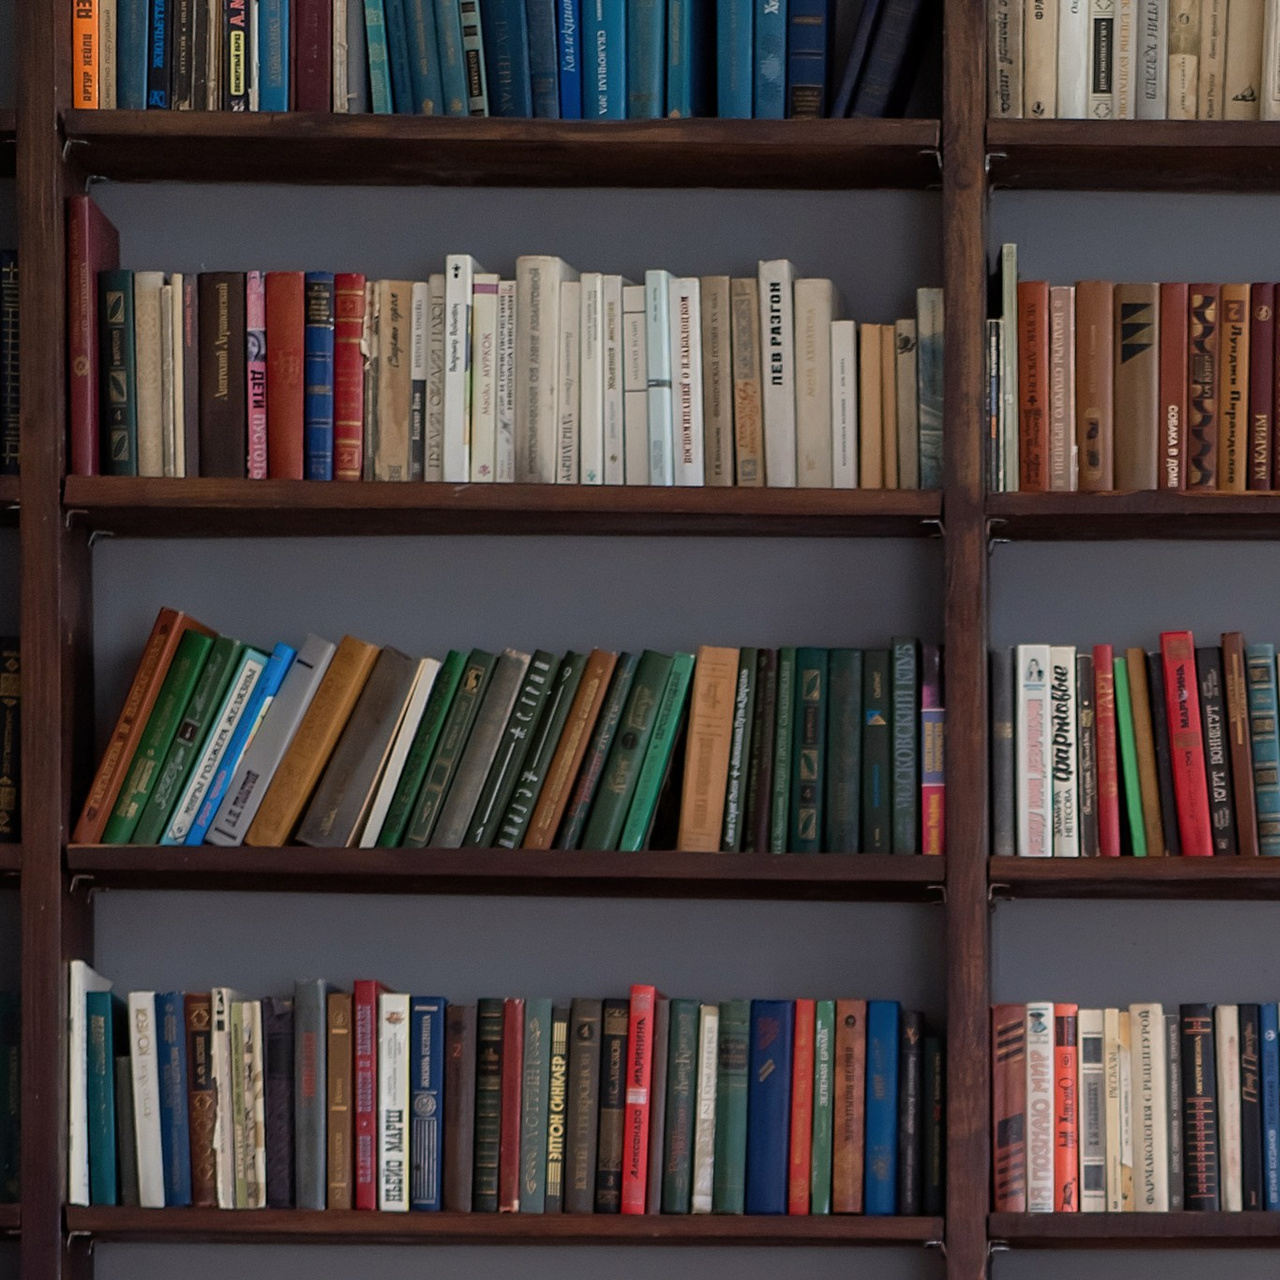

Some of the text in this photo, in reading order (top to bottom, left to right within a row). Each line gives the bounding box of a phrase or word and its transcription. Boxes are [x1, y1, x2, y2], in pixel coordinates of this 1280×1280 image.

[82, 34, 92, 101] АРТУР ХЕЙЛИ
[213, 283, 231, 399] Анатолий Аграновский
[769, 281, 784, 386] ЛЕВ РАЗГОН
[1167, 405, 1179, 488] СОБАКА В ДОМЕ
[894, 644, 915, 810] МОСКОВСКИЙ КЛУБ
[1176, 664, 1190, 729] МАРИНИНА
[1206, 705, 1226, 802] КУРТ ВОННЕГУТ
[1063, 788, 1073, 838] НЕТЕСОВА
[383, 1109, 403, 1202] НЬЕЙО МАРШ
[549, 1056, 566, 1161] ЭПТОН СИНКЛЕР
[1028, 1051, 1050, 1200] Я ПОЗНАЮ МИР
[1138, 1009, 1156, 1206] ФАРМАКОЛОГИЯ С РЕЦЕПТУРОЙ
